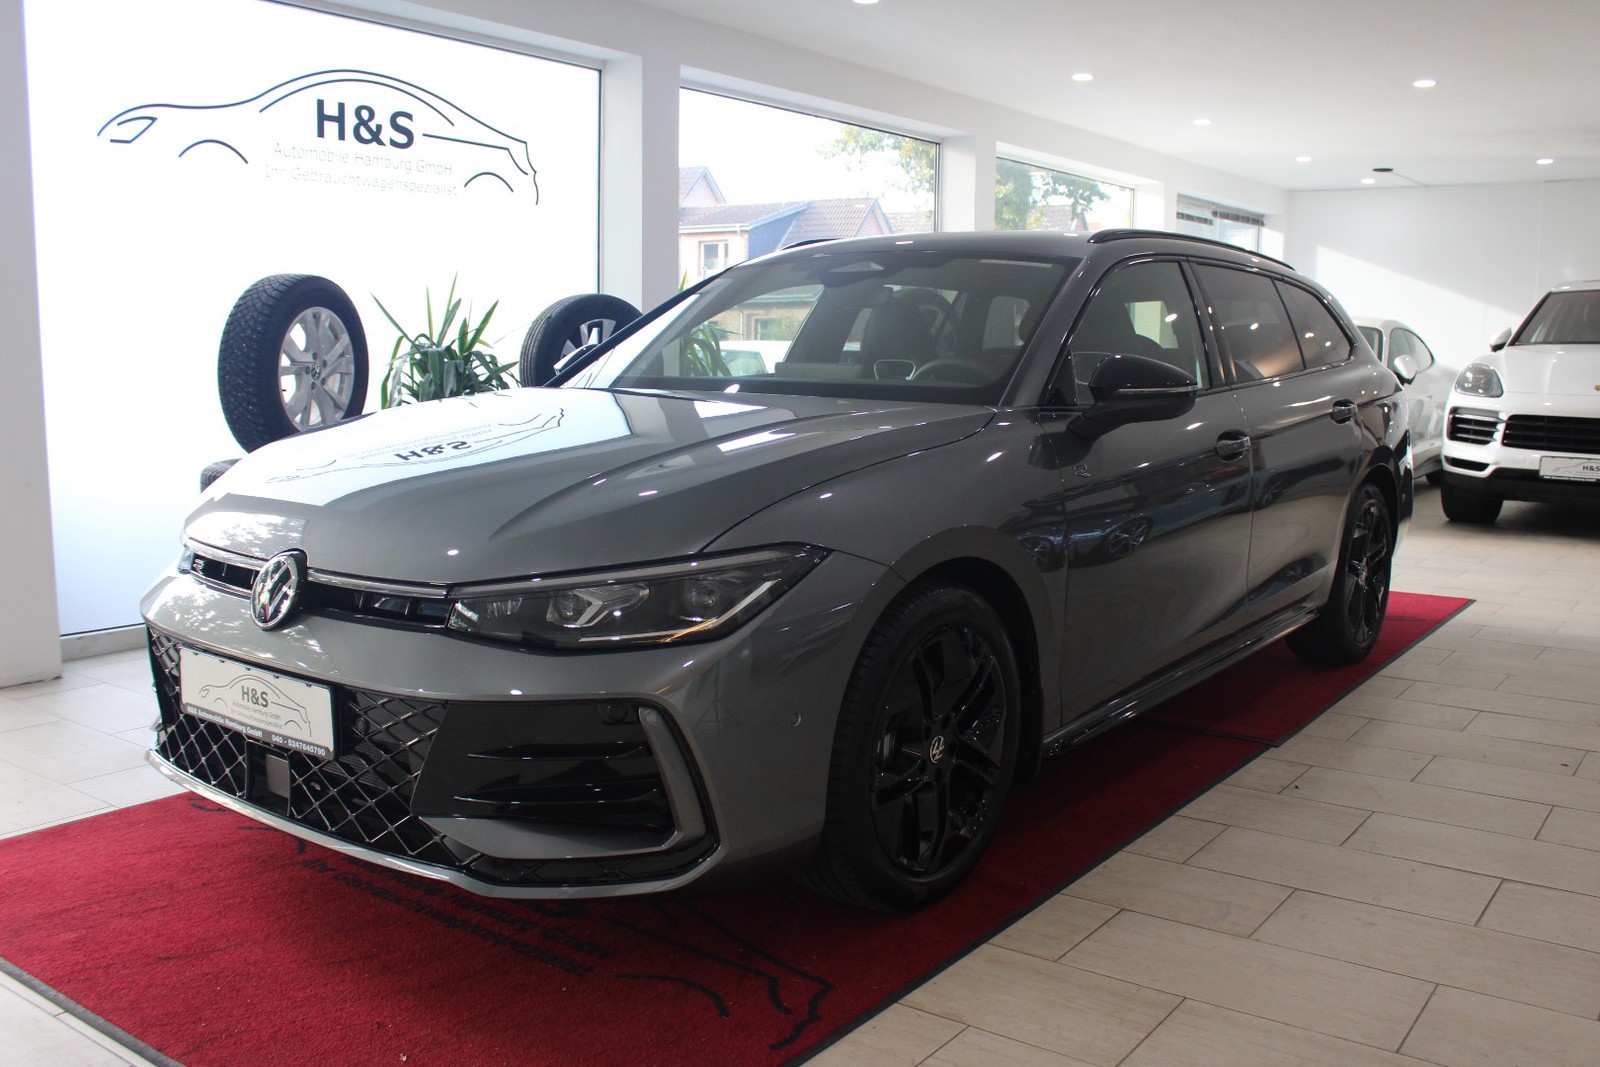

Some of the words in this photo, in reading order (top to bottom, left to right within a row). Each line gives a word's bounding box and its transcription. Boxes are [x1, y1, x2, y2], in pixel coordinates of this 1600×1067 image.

[316, 98, 415, 149] H&S
[274, 142, 350, 164] Automobile
[354, 151, 412, 174] Hamburg
[416, 159, 452, 175] GmbH
[241, 685, 269, 708] H&S
[246, 726, 263, 738] GmbH
